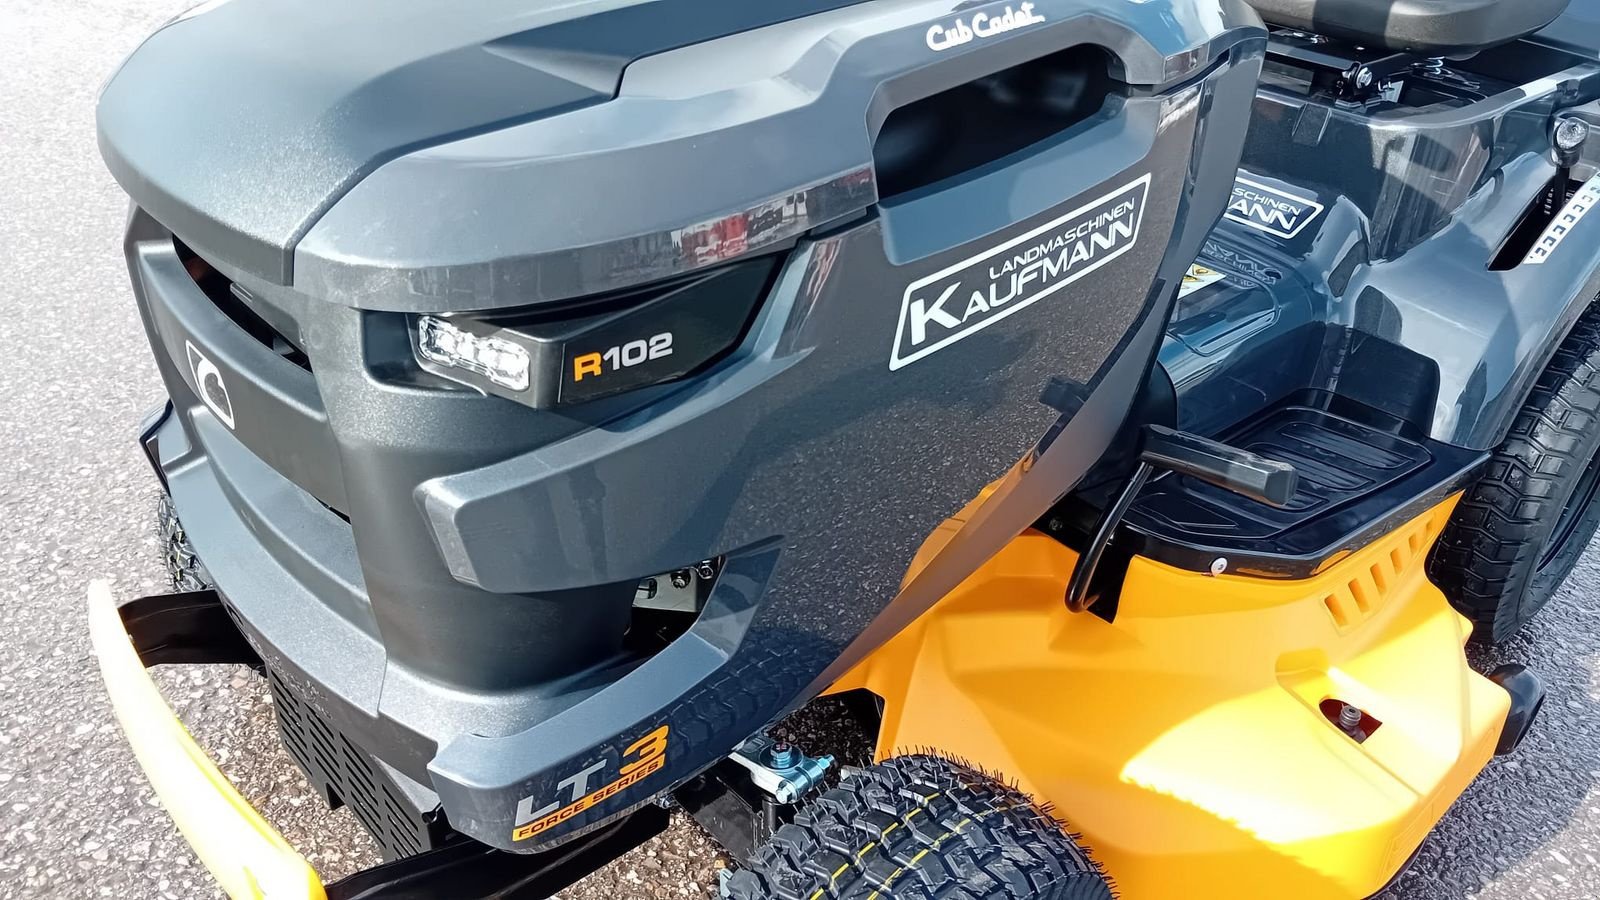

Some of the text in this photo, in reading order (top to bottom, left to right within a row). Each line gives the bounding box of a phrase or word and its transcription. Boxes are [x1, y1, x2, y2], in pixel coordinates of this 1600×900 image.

[926, 1, 1046, 52] Cub Cadet
[1227, 195, 1297, 230] ANN
[1231, 187, 1302, 216] SCHINEN
[989, 197, 1136, 281] LANDMASCHINEN
[909, 213, 1134, 346] KAUFMANN
[573, 332, 673, 383] R102
[518, 760, 659, 839] FORCE SERIES
